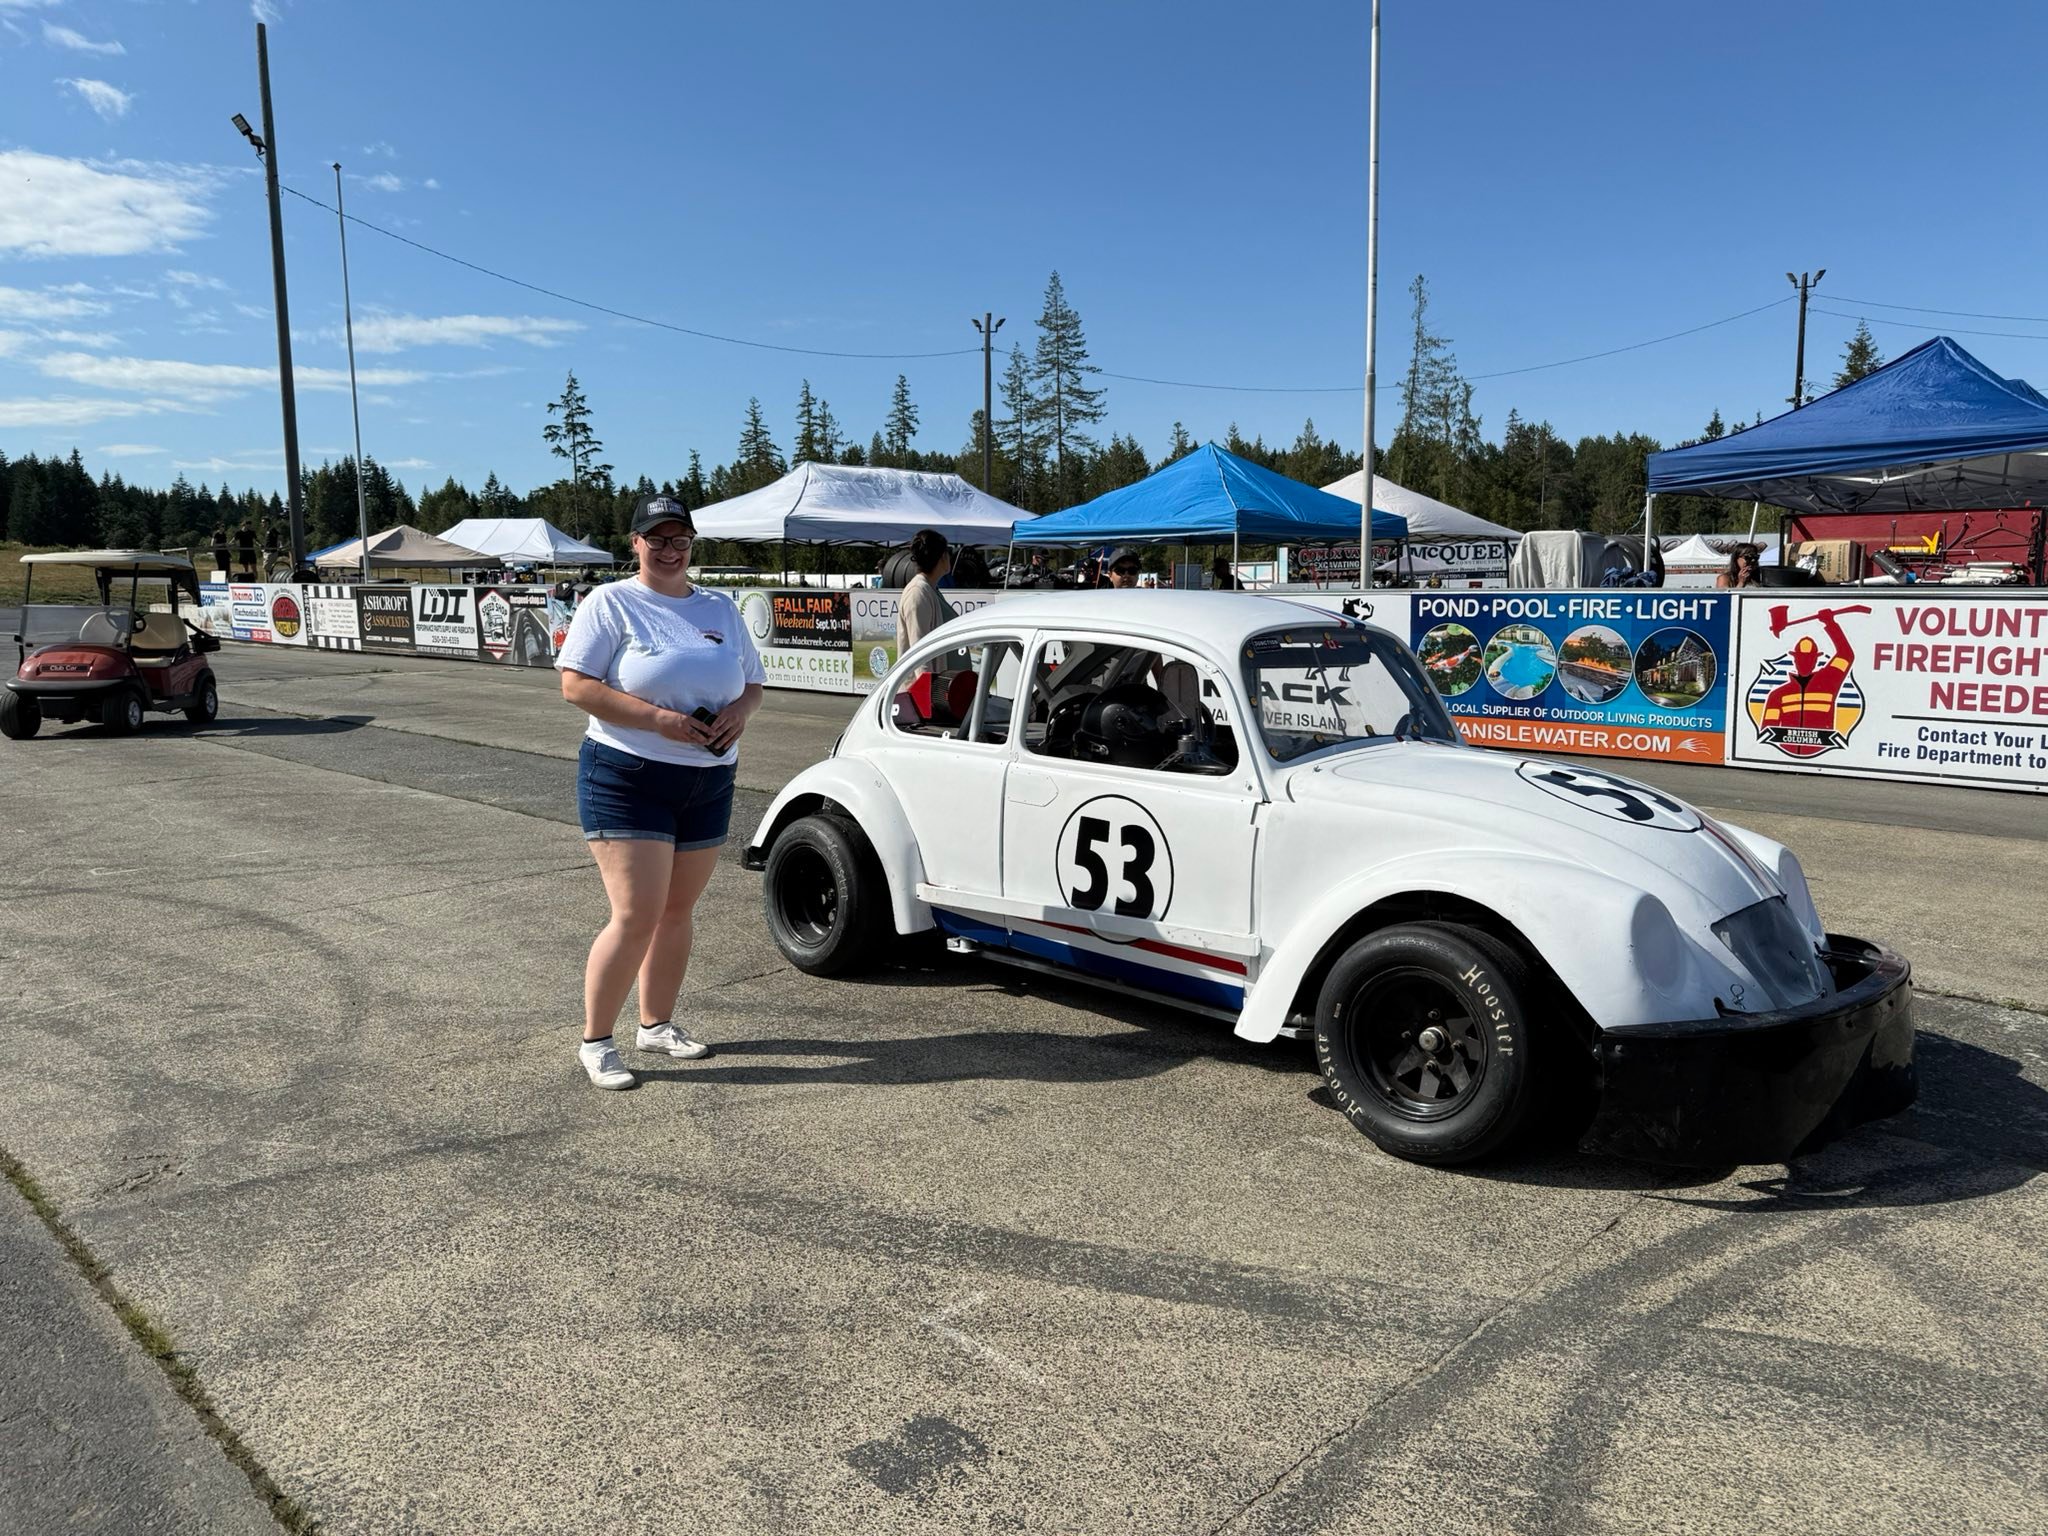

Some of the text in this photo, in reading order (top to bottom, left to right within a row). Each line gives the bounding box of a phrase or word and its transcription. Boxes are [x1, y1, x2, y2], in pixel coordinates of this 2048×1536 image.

[363, 595, 408, 611] ASHCROFT
[419, 588, 468, 623] LDI
[482, 603, 508, 616] SPEED SHOP
[779, 598, 832, 614] FALL FAIR
[856, 600, 899, 617] OCEA
[1418, 599, 1718, 620] POND POOL FIRE LIGHT
[371, 615, 410, 628] ASSOCIATES
[775, 613, 815, 629] Weekend
[816, 619, 829, 631] Sept.
[773, 636, 849, 648] www.blackcreek-cc.com
[763, 655, 848, 674] BLACK CREEK
[819, 676, 849, 687] centre
[1297, 713, 1347, 731] ISLAND
[1456, 721, 1671, 753] ANISLEWATER.COM
[1782, 735, 1822, 745] COLUMBIA
[1787, 729, 1818, 738] BRITISH
[1918, 726, 1987, 746] Contact
[1994, 731, 2034, 749] Your
[1878, 742, 2047, 769] Fire Department to
[1071, 816, 1155, 919] 53
[1460, 964, 1514, 1057] Hoosier
[1318, 1033, 1364, 1120] Hoosier
